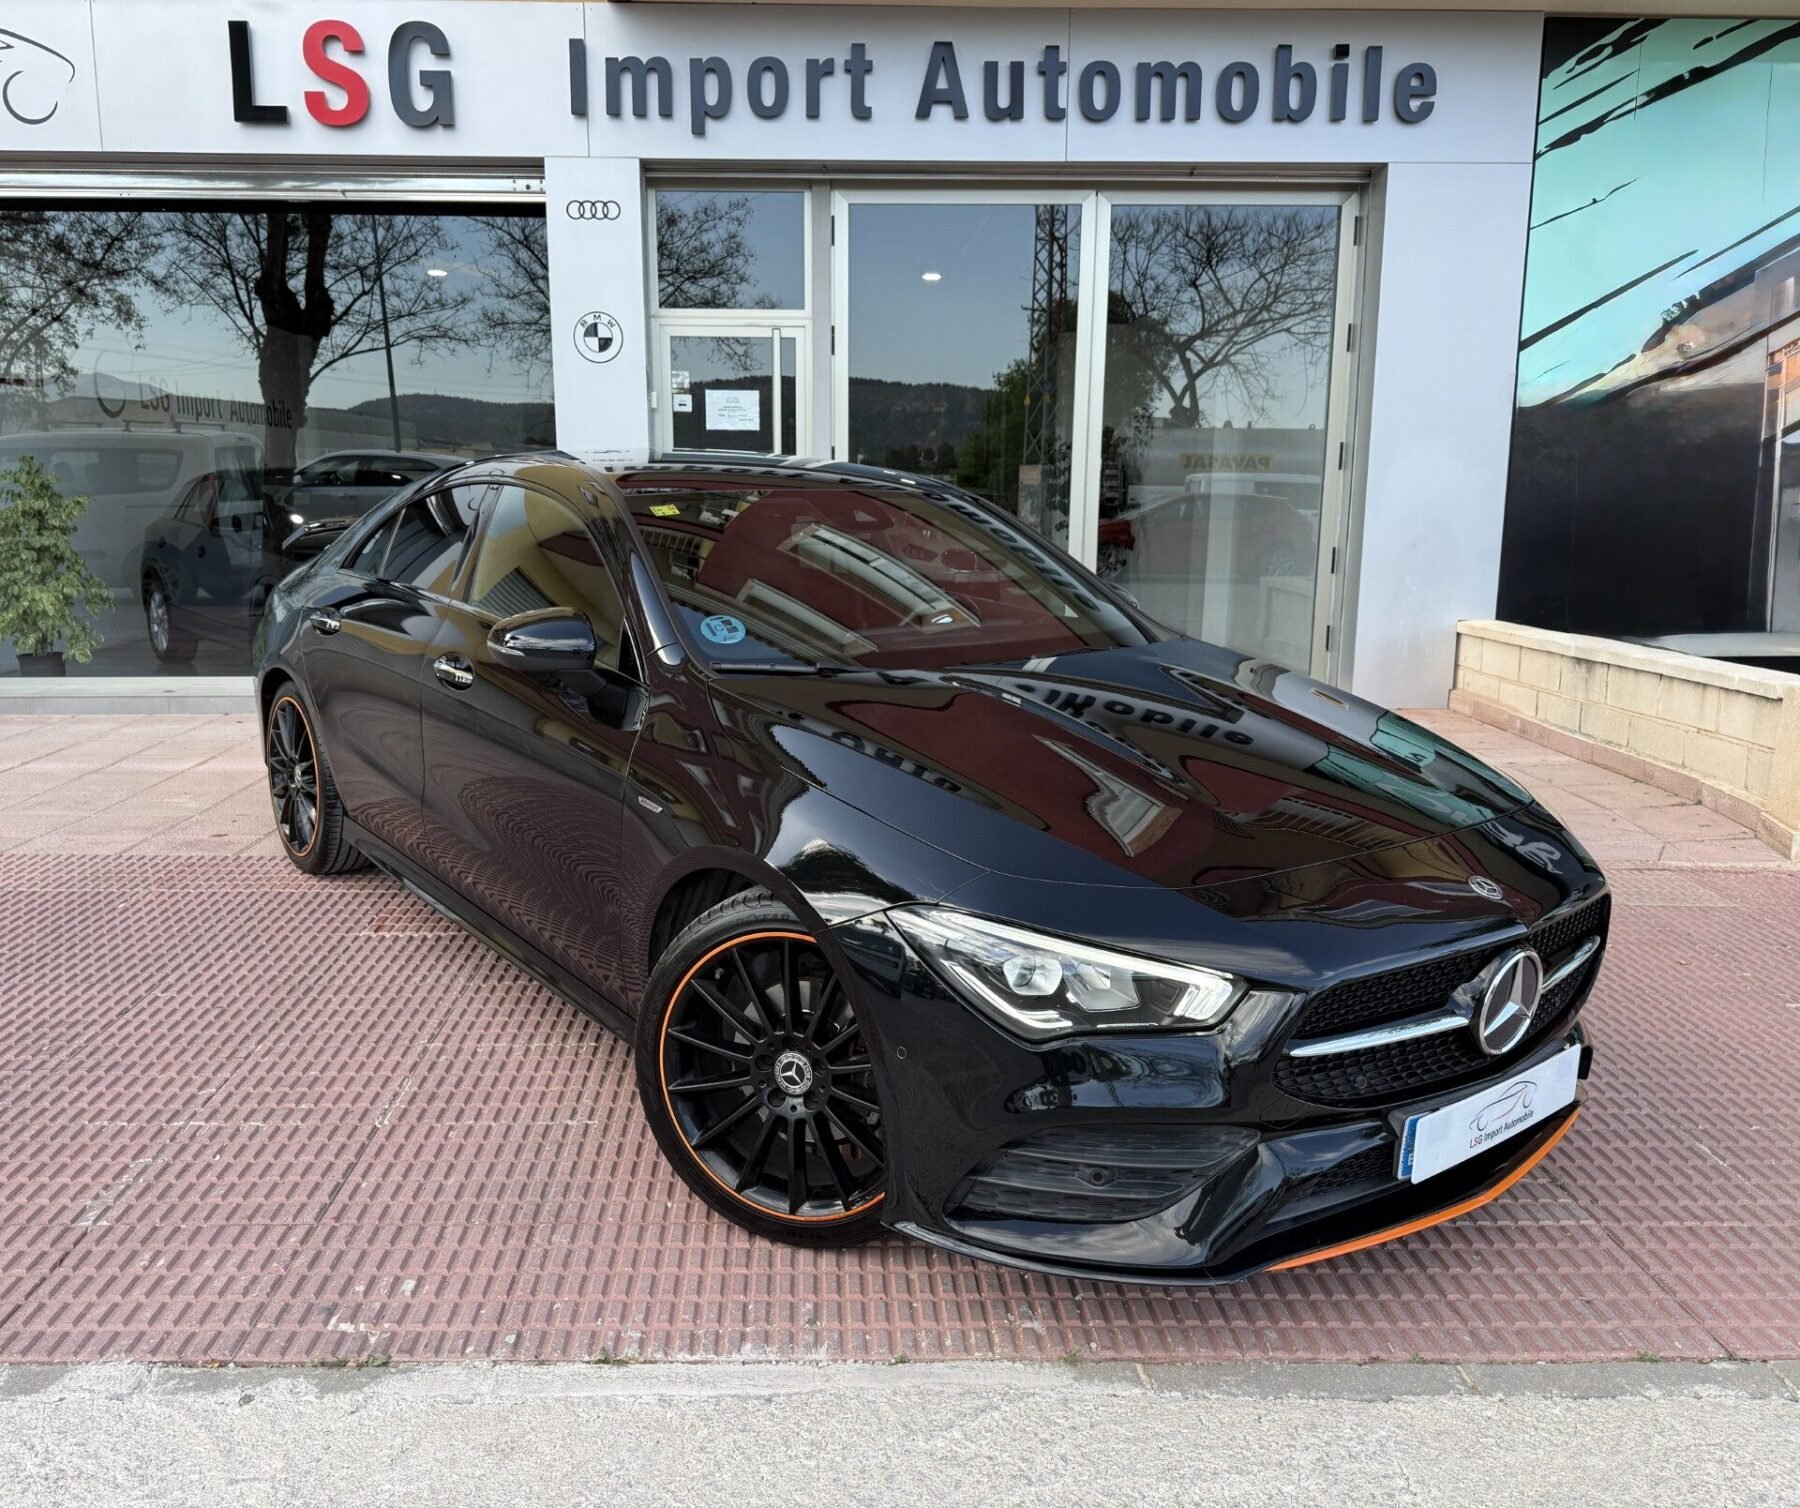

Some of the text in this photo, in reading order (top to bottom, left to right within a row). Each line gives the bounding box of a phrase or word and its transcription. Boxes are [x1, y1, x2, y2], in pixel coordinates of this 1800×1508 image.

[227, 20, 1438, 138] LSG Import Automobile
[580, 314, 616, 328] BMW
[139, 374, 293, 430] LSG Import Automobile
[1469, 1109, 1534, 1149] LSG Import Automobile
